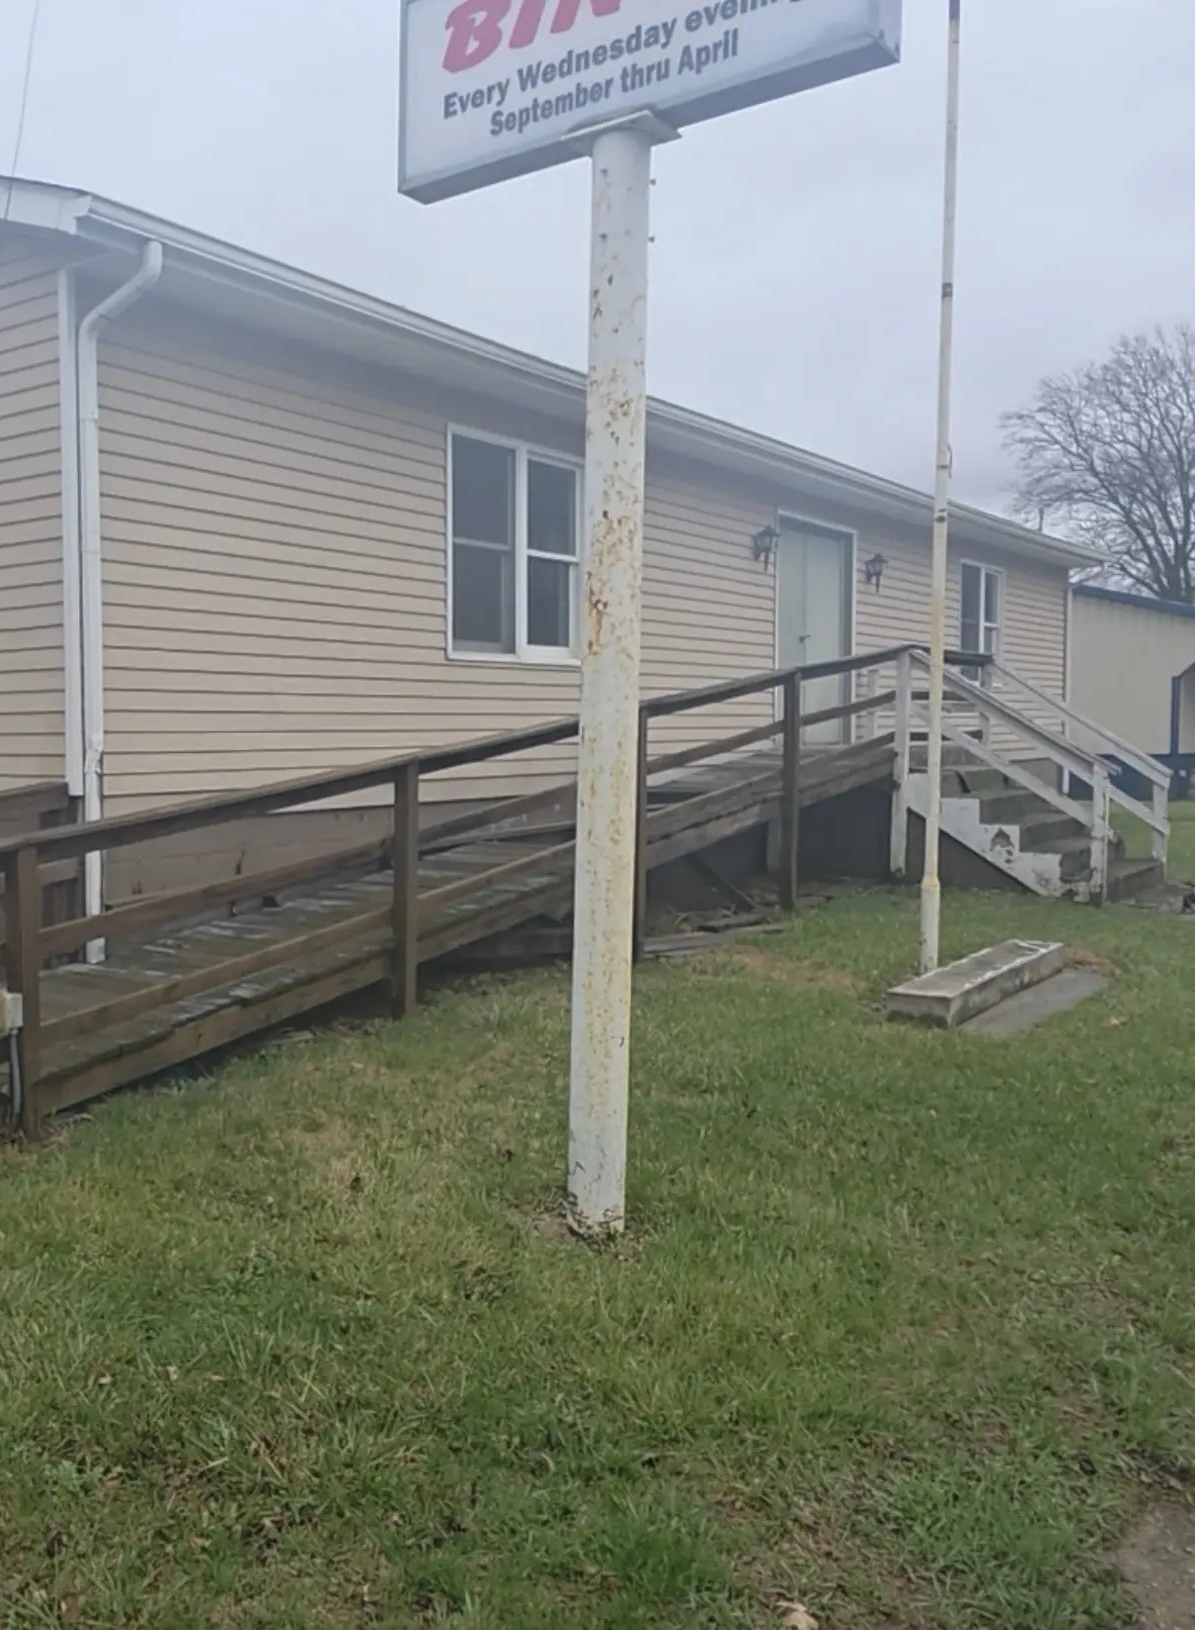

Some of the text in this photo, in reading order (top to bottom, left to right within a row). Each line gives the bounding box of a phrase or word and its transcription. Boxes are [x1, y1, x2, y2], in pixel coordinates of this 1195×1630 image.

[442, 78, 511, 119] Every
[516, 16, 678, 93] Wednesday
[490, 27, 739, 137] September thru April
